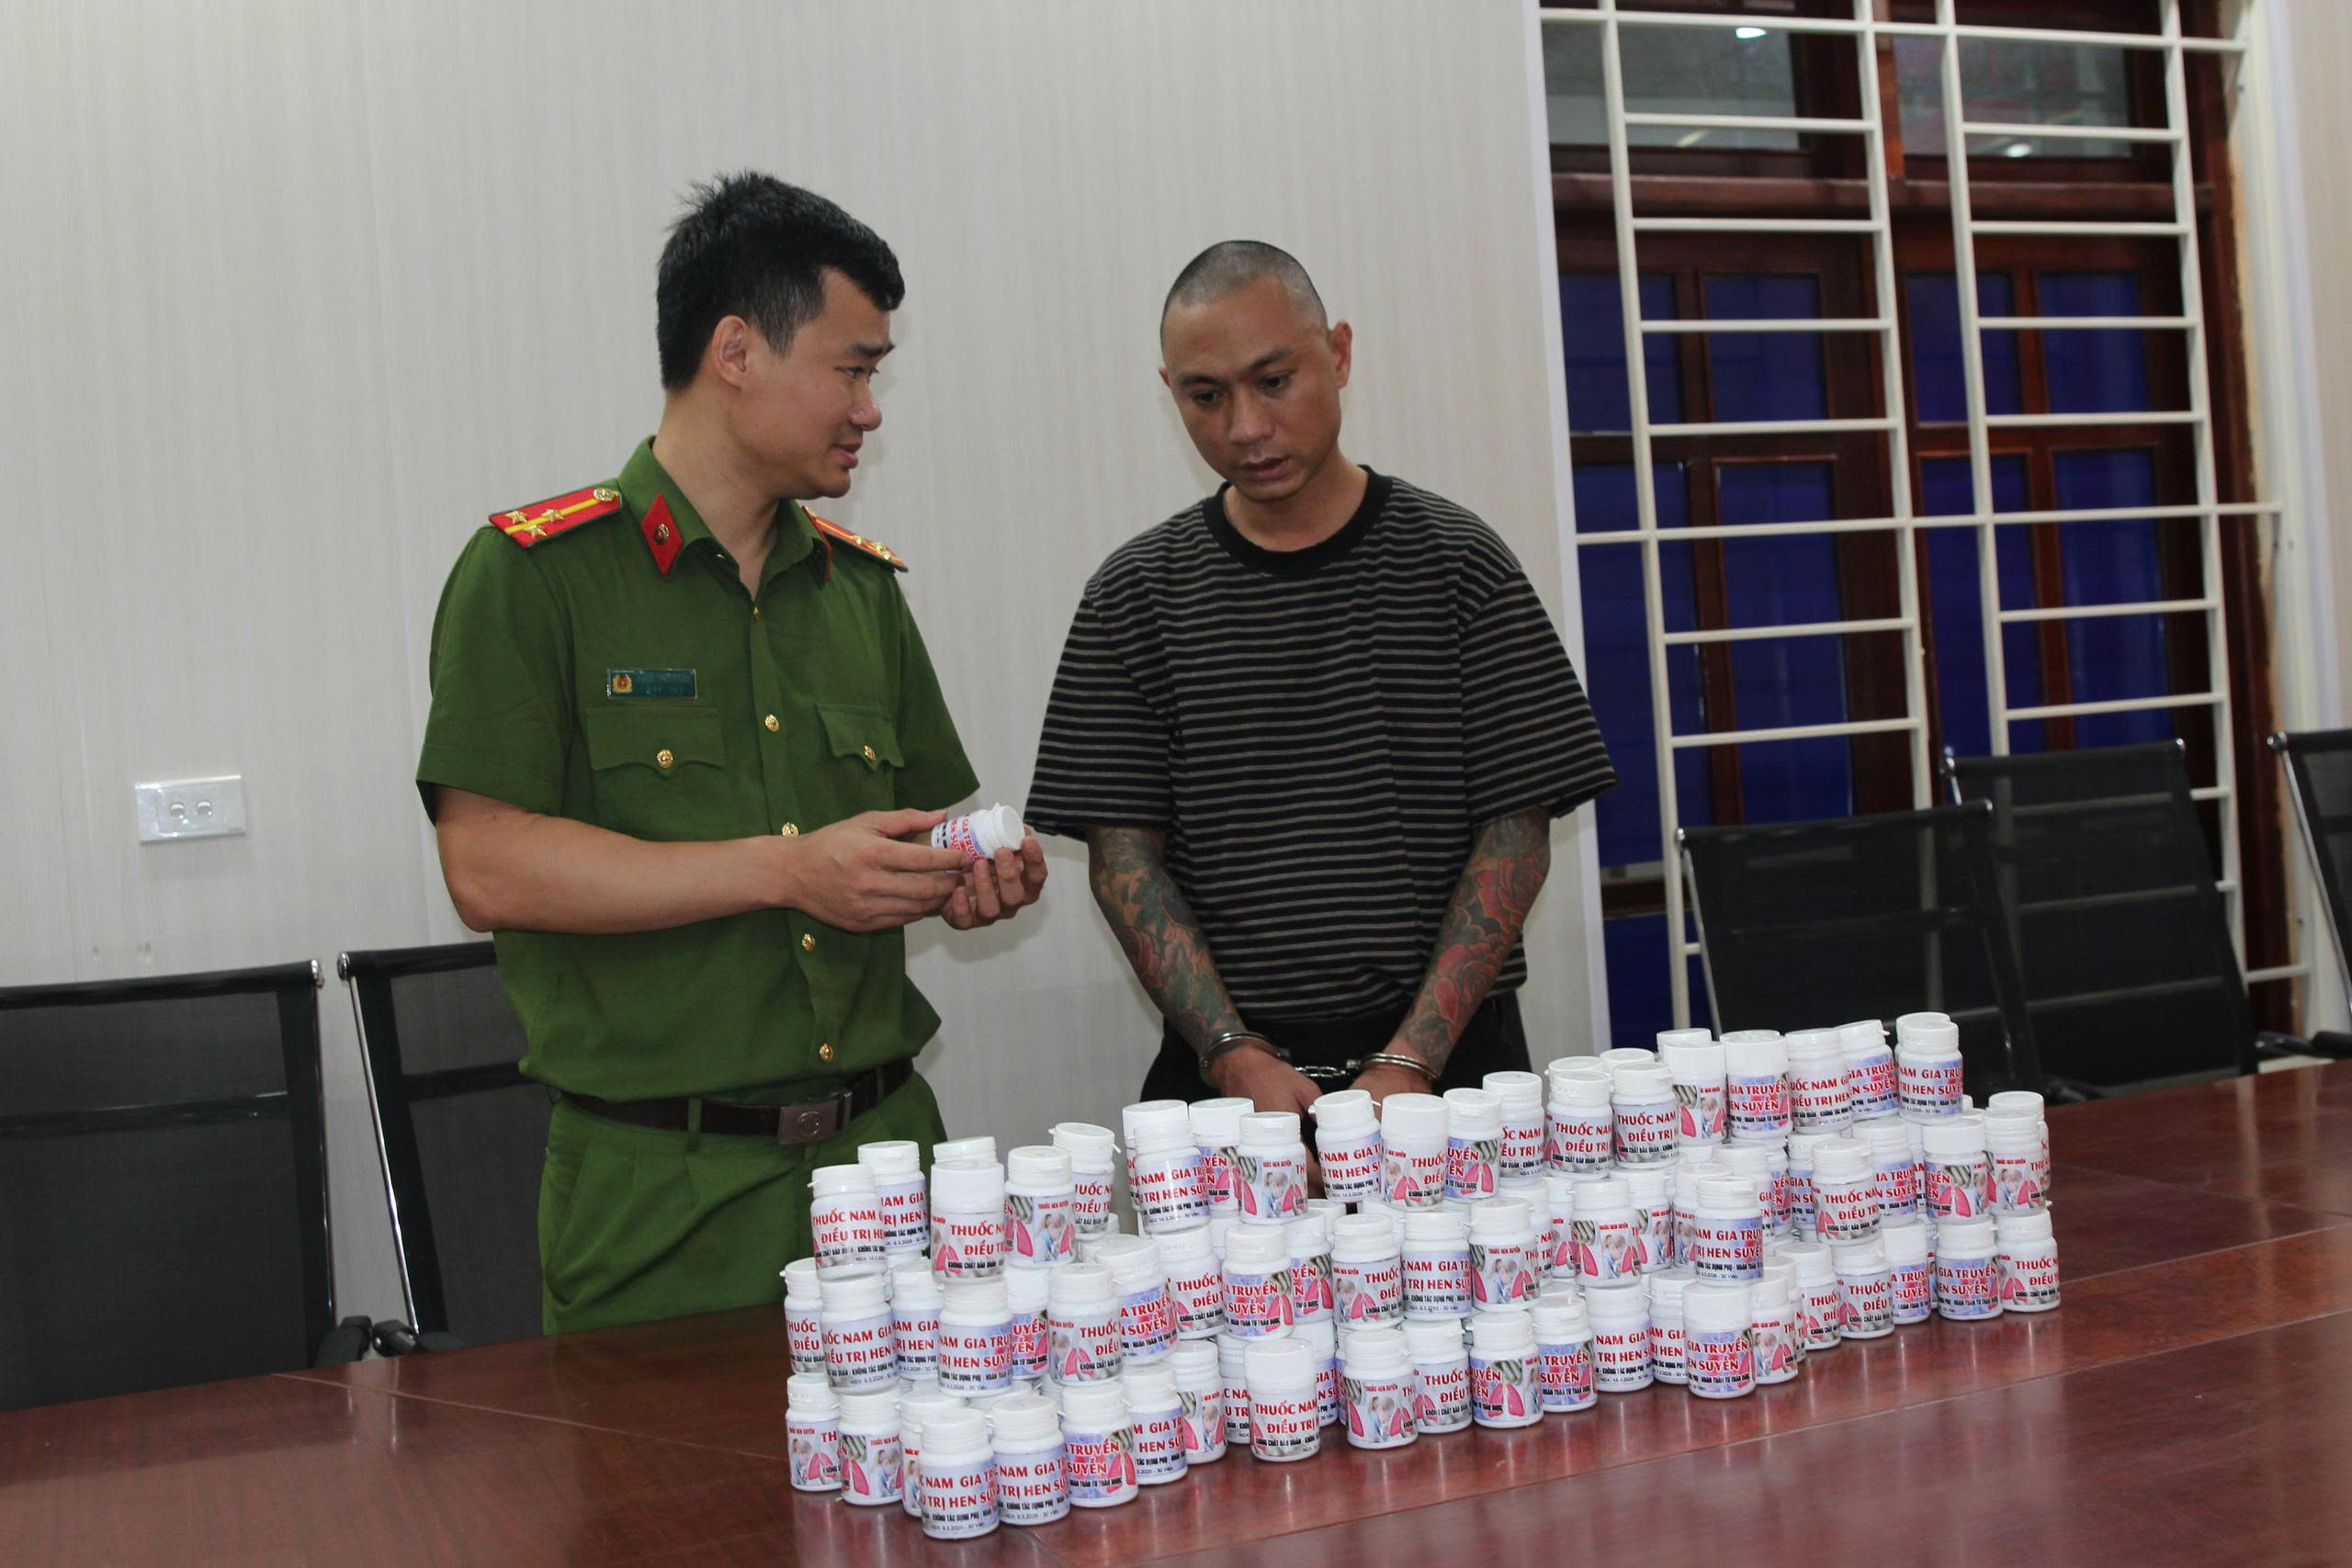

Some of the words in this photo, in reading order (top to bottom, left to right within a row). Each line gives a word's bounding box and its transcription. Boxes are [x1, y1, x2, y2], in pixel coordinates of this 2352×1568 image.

[1922, 1069, 1940, 1078] GIA
[1730, 1085, 1744, 1094] GIA
[1812, 1079, 1837, 1090] NAM
[1913, 1087, 1934, 1095] HEN
[1815, 1097, 1831, 1107] TRỊ
[1617, 1111, 1653, 1124] THUỐC
[1657, 1111, 1676, 1124] NAM
[1519, 1128, 1541, 1139] NAM
[1555, 1122, 1593, 1135] THUỐC
[1628, 1129, 1655, 1142] ĐIỀU
[1657, 1130, 1673, 1141] TRỊ
[1520, 1146, 1535, 1157] TRỊ
[1565, 1139, 1592, 1152] ĐIỀU
[1325, 1151, 1348, 1162] NAM
[1353, 1147, 1373, 1160] GIA
[1411, 1151, 1445, 1168] THUỐC
[1448, 1146, 1479, 1160] UYỀN
[1142, 1172, 1165, 1184] NAM
[1171, 1168, 1191, 1179] GIA
[1328, 1168, 1343, 1179] TRỊ
[1347, 1165, 1370, 1178] HEN
[1144, 1192, 1159, 1203] TRỊ
[1826, 1190, 1862, 1203] THUỐC
[813, 1208, 845, 1226] THUỐC
[850, 1211, 876, 1221] NAM
[884, 1215, 897, 1227] RỊ
[900, 1213, 921, 1224] HEN
[1838, 1206, 1865, 1220] ĐIỀU
[821, 1227, 847, 1243] ĐIỀU
[853, 1230, 870, 1242] TRỊ
[950, 1220, 993, 1236] THUỐC
[1716, 1230, 1737, 1240] GIA
[964, 1240, 993, 1256] ĐIỀU
[1707, 1247, 1731, 1258] HEN
[1407, 1261, 1431, 1270] NAM
[1439, 1260, 1457, 1270] GIA
[2016, 1256, 2051, 1269] THUỐC
[1365, 1266, 1399, 1283] THUỐC
[1939, 1268, 1952, 1278] GIA
[1956, 1265, 1996, 1279] TRUYỀN
[1176, 1272, 1216, 1292] THUỐC
[1408, 1280, 1424, 1292] TRỊ
[1428, 1279, 1453, 1289] HEN
[2029, 1273, 2052, 1286] ĐIỀU
[1232, 1281, 1277, 1295] TRUYỀN
[1849, 1280, 1885, 1295] THUỐC
[1193, 1291, 1218, 1308] ĐIỀU
[1229, 1298, 1265, 1314] SUYỄN
[1863, 1297, 1886, 1312] ĐIỀU
[918, 1321, 939, 1330] GIA
[1013, 1319, 1046, 1335] UYỀN
[1080, 1319, 1118, 1337] THUỐC
[843, 1331, 873, 1343] NAM
[1596, 1335, 1623, 1345] NAM
[1629, 1332, 1645, 1344] GIA
[1668, 1330, 1686, 1339] GIA
[794, 1337, 819, 1350] ĐIỀU
[909, 1339, 933, 1349] HEN
[965, 1338, 987, 1348] GIA
[1095, 1337, 1119, 1356] ĐIỀU
[1703, 1337, 1747, 1353] TRUYỀN
[846, 1351, 865, 1367] TRỊ
[871, 1347, 891, 1359] HEN
[1544, 1349, 1589, 1365] TRUYỀN
[1598, 1352, 1615, 1365] TRỊ
[1620, 1350, 1642, 1361] HEN
[1660, 1348, 1682, 1357] HEN
[954, 1358, 979, 1367] HEN
[1700, 1357, 1738, 1371] SUYỄN
[1424, 1368, 1463, 1385] THUỐC
[1542, 1368, 1579, 1383] SUYỄN
[1440, 1387, 1465, 1402] ĐIỀU
[1255, 1400, 1295, 1415] THUỐC
[1299, 1399, 1317, 1413] NAM
[1149, 1421, 1170, 1433] GIA
[1267, 1419, 1297, 1433] ĐIỀU
[1070, 1439, 1119, 1454] TRUYỀN
[1139, 1441, 1165, 1452] HEN
[1000, 1466, 1027, 1477] NAM
[1035, 1462, 1055, 1474] GIA
[926, 1477, 953, 1488] NAM
[960, 1474, 981, 1487] GIA
[1002, 1485, 1020, 1498] TRỊ
[1023, 1483, 1051, 1496] HEN
[929, 1496, 945, 1510] TRỊ
[949, 1496, 977, 1507] HEN
